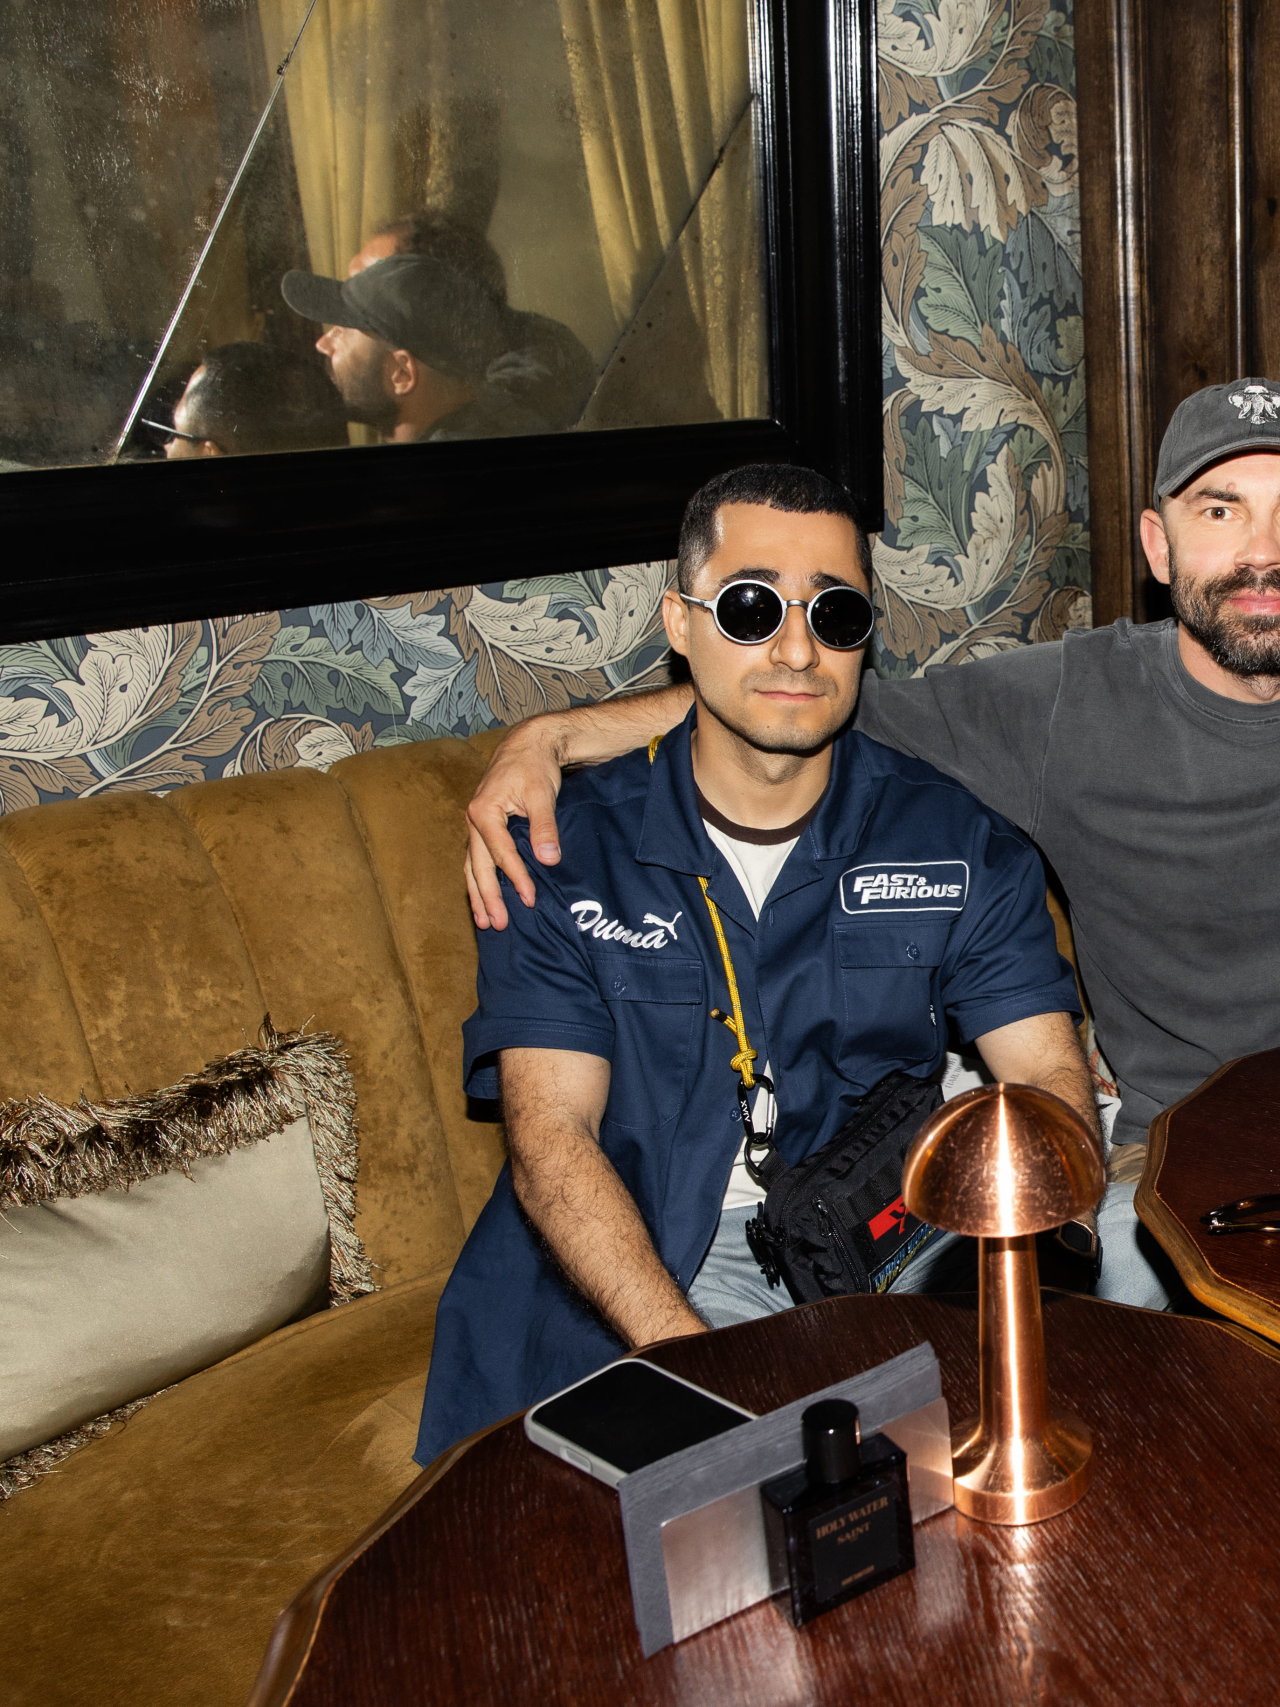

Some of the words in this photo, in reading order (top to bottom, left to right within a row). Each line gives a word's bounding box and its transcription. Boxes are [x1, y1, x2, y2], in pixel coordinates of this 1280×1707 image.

[861, 884, 963, 905] FURIOUS
[815, 1515, 847, 1540] HOLY
[848, 1496, 888, 1522] WATER
[837, 1522, 870, 1545] SAINT
